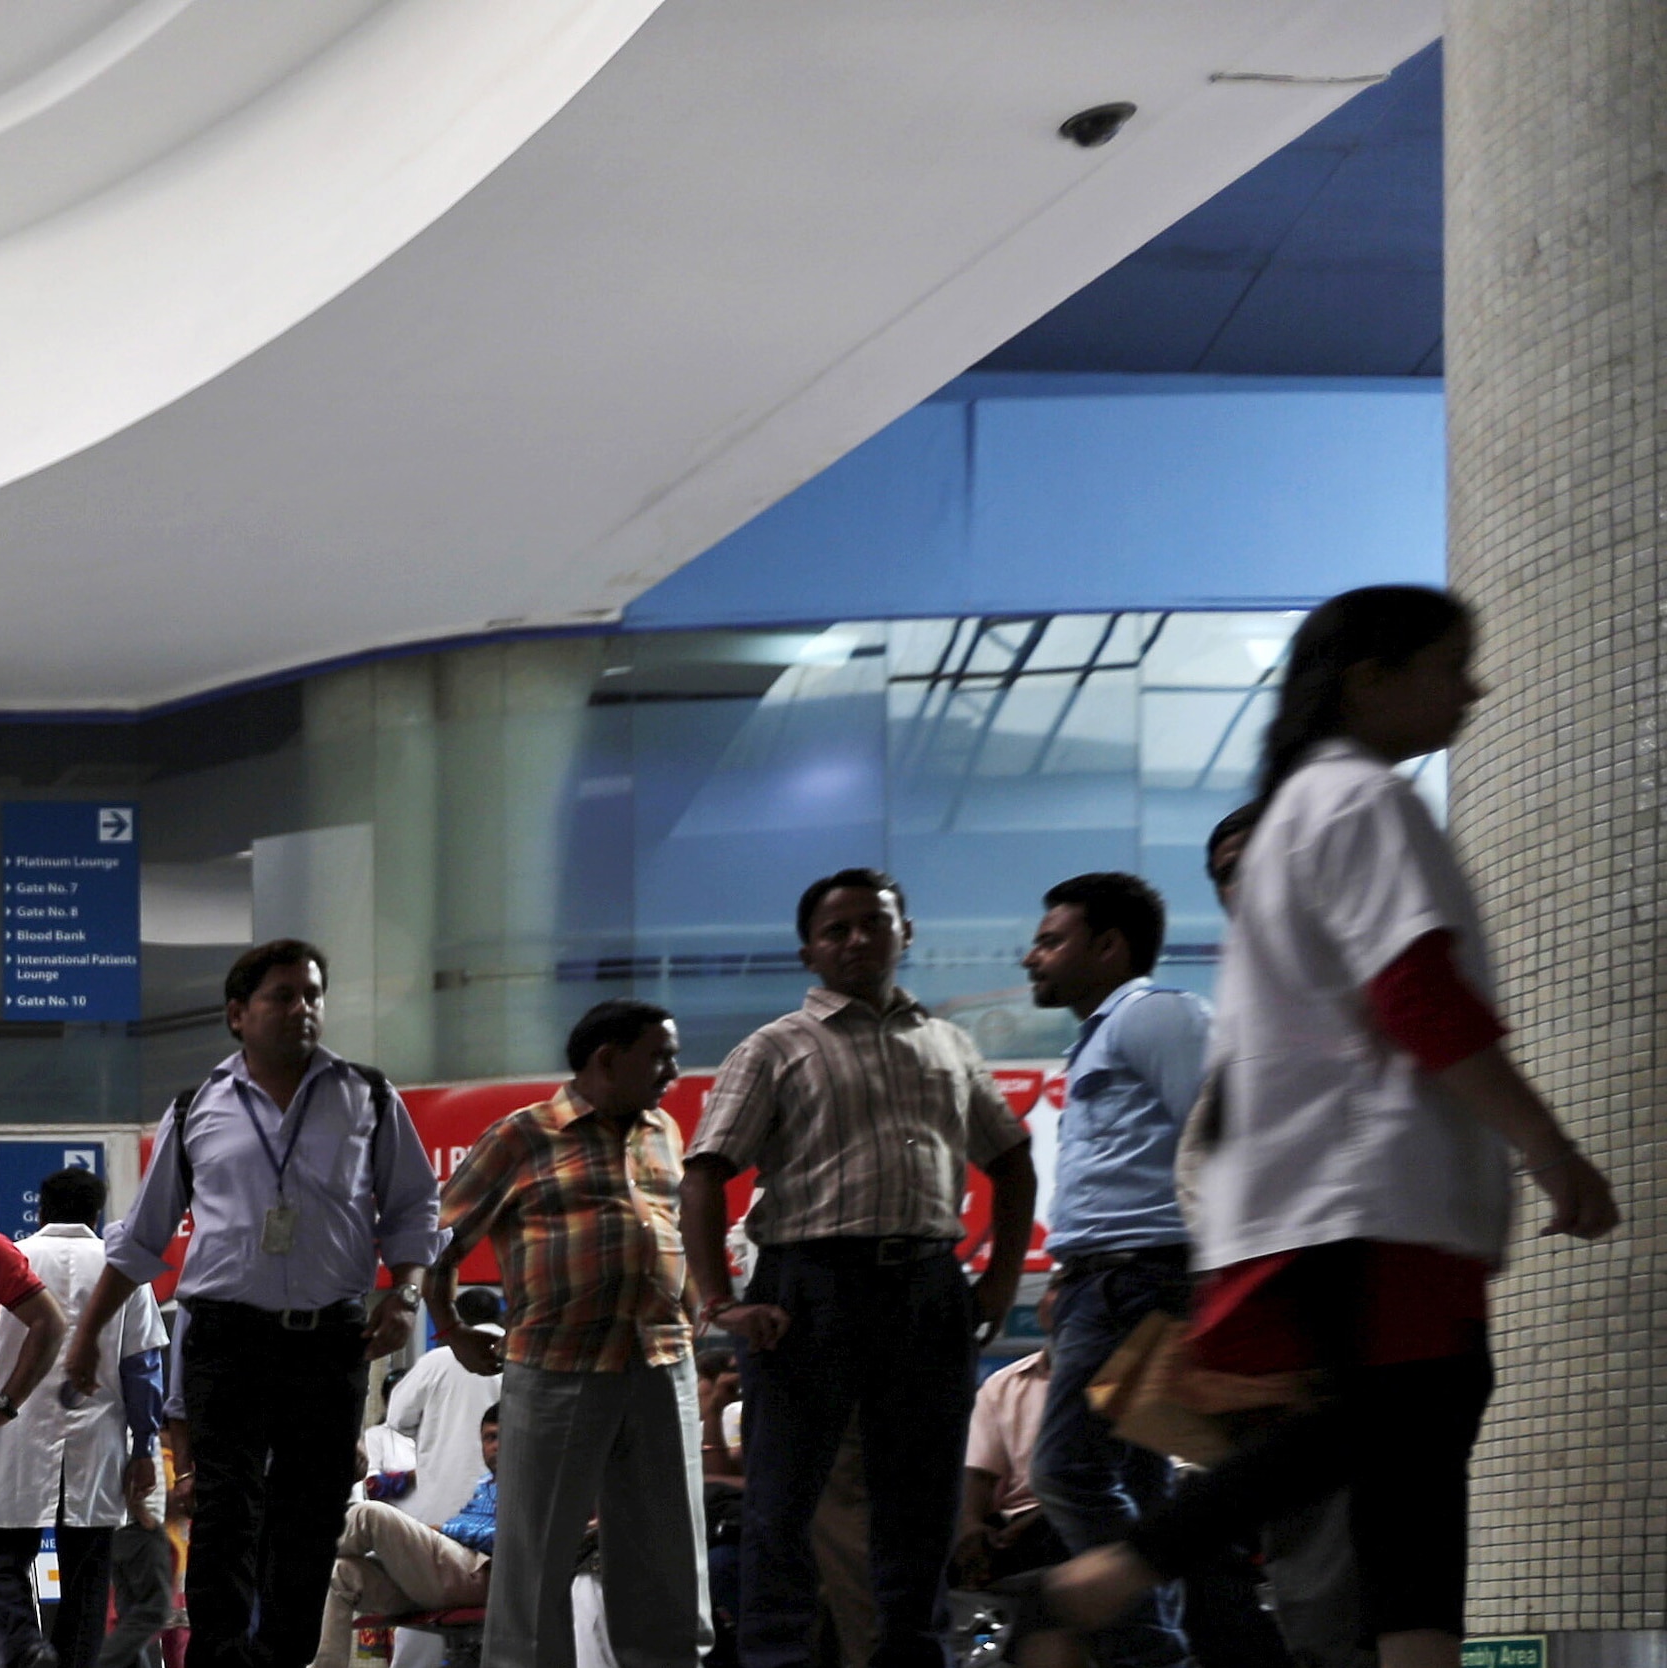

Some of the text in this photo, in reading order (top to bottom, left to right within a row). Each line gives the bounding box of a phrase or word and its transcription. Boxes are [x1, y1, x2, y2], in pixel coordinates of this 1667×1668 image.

[16, 856, 120, 871] Platinum Lounge
[16, 882, 79, 894] Gate No. 7
[16, 906, 45, 917] Gate
[48, 907, 69, 917] No.
[16, 929, 86, 941] Blood Bank
[16, 953, 137, 965] International Patients
[16, 968, 60, 982] Lounge
[16, 995, 87, 1006] Gate No. 10
[1499, 1645, 1537, 1665] Area
